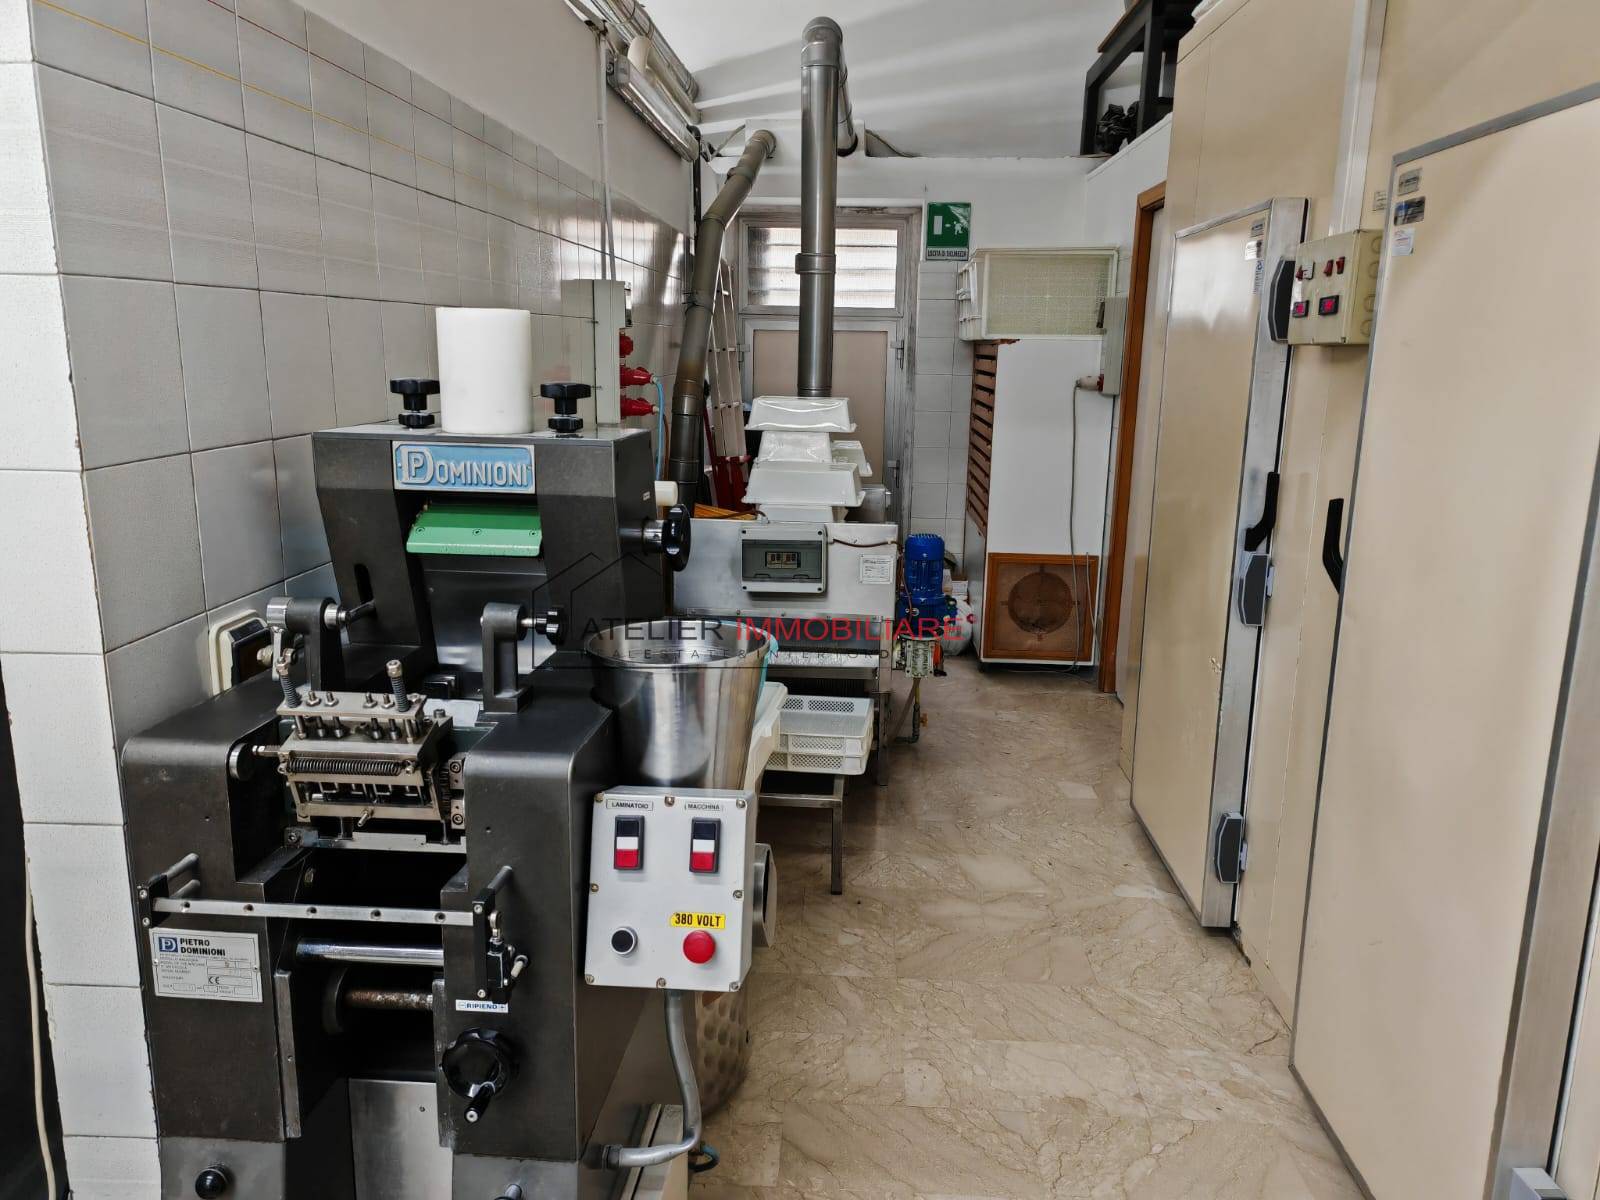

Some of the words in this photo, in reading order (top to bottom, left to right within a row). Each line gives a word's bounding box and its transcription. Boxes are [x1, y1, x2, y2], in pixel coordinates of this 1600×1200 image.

[612, 801, 649, 809] LAMINATOIO
[688, 803, 720, 811] MACCHINA
[674, 913, 693, 925] 380
[697, 914, 721, 927] VOLT
[180, 938, 210, 947] PIETRO
[180, 946, 226, 956] DOMINIONI
